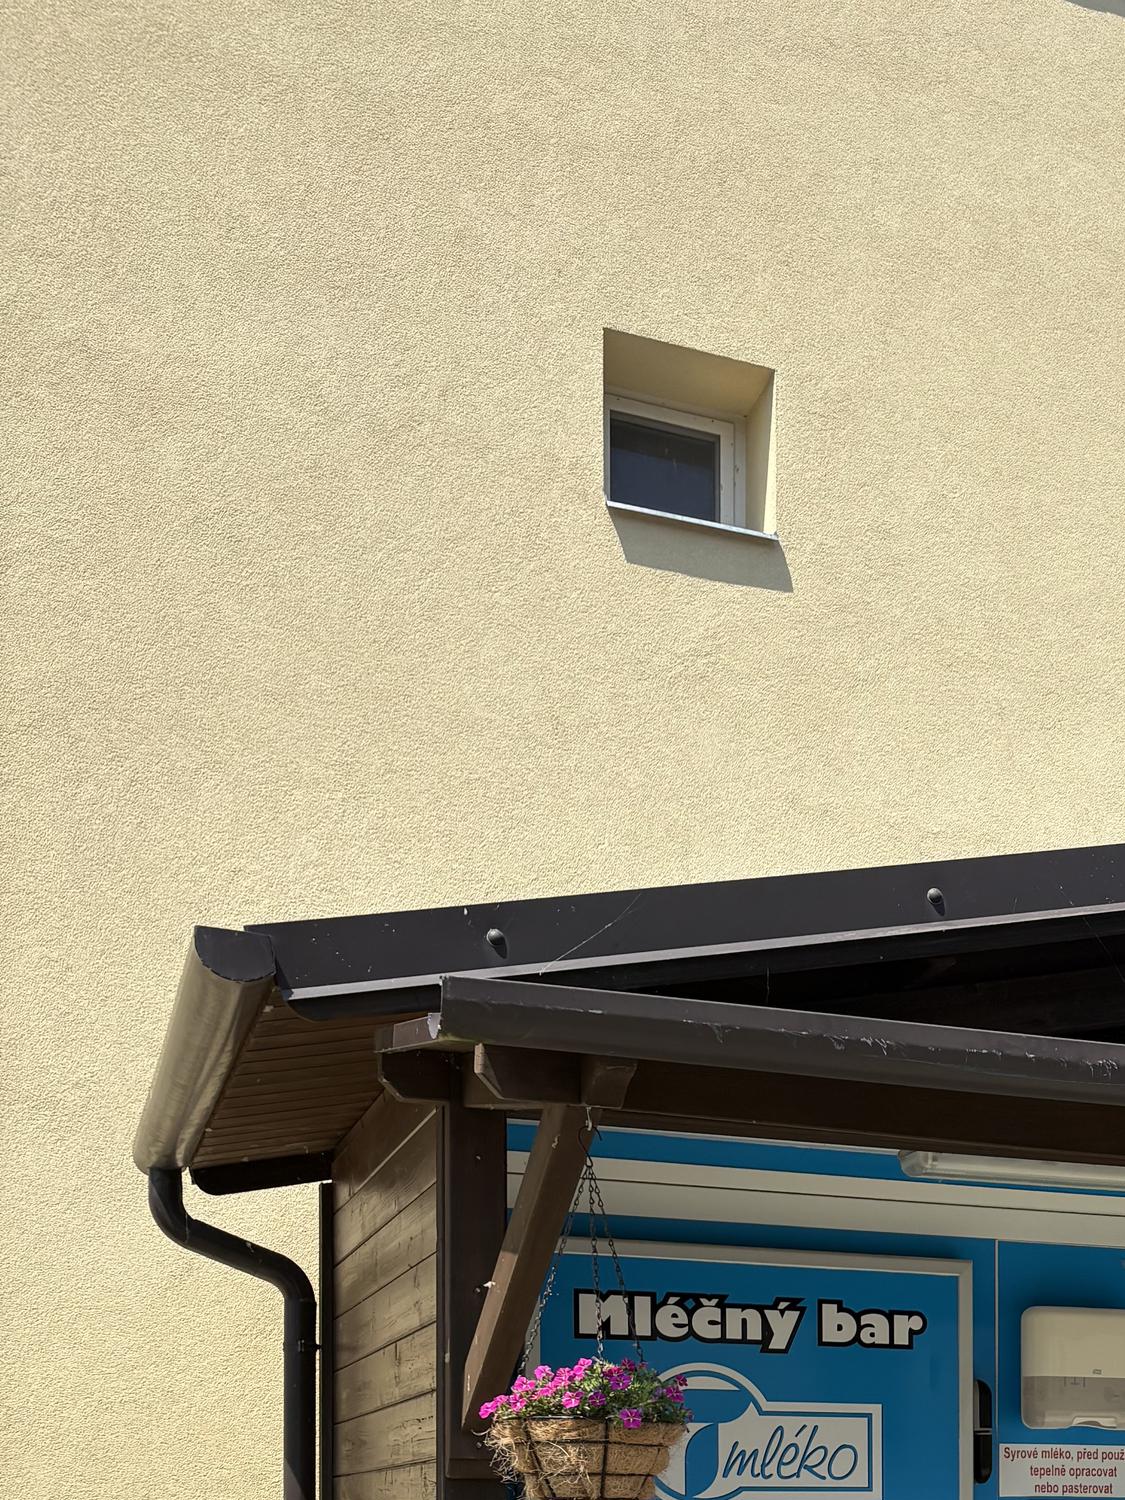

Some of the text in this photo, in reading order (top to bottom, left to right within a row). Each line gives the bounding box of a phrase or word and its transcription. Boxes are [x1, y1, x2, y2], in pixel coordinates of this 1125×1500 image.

[574, 1289, 927, 1352] Mléčný bar
[723, 1425, 859, 1481] mléko
[1004, 1447, 1038, 1461] Syrové
[1041, 1448, 1074, 1460] mléko,
[1077, 1448, 1098, 1461] před
[1030, 1464, 1117, 1478] tepelně opracovat
[1034, 1482, 1113, 1495] nebo pasterovat
